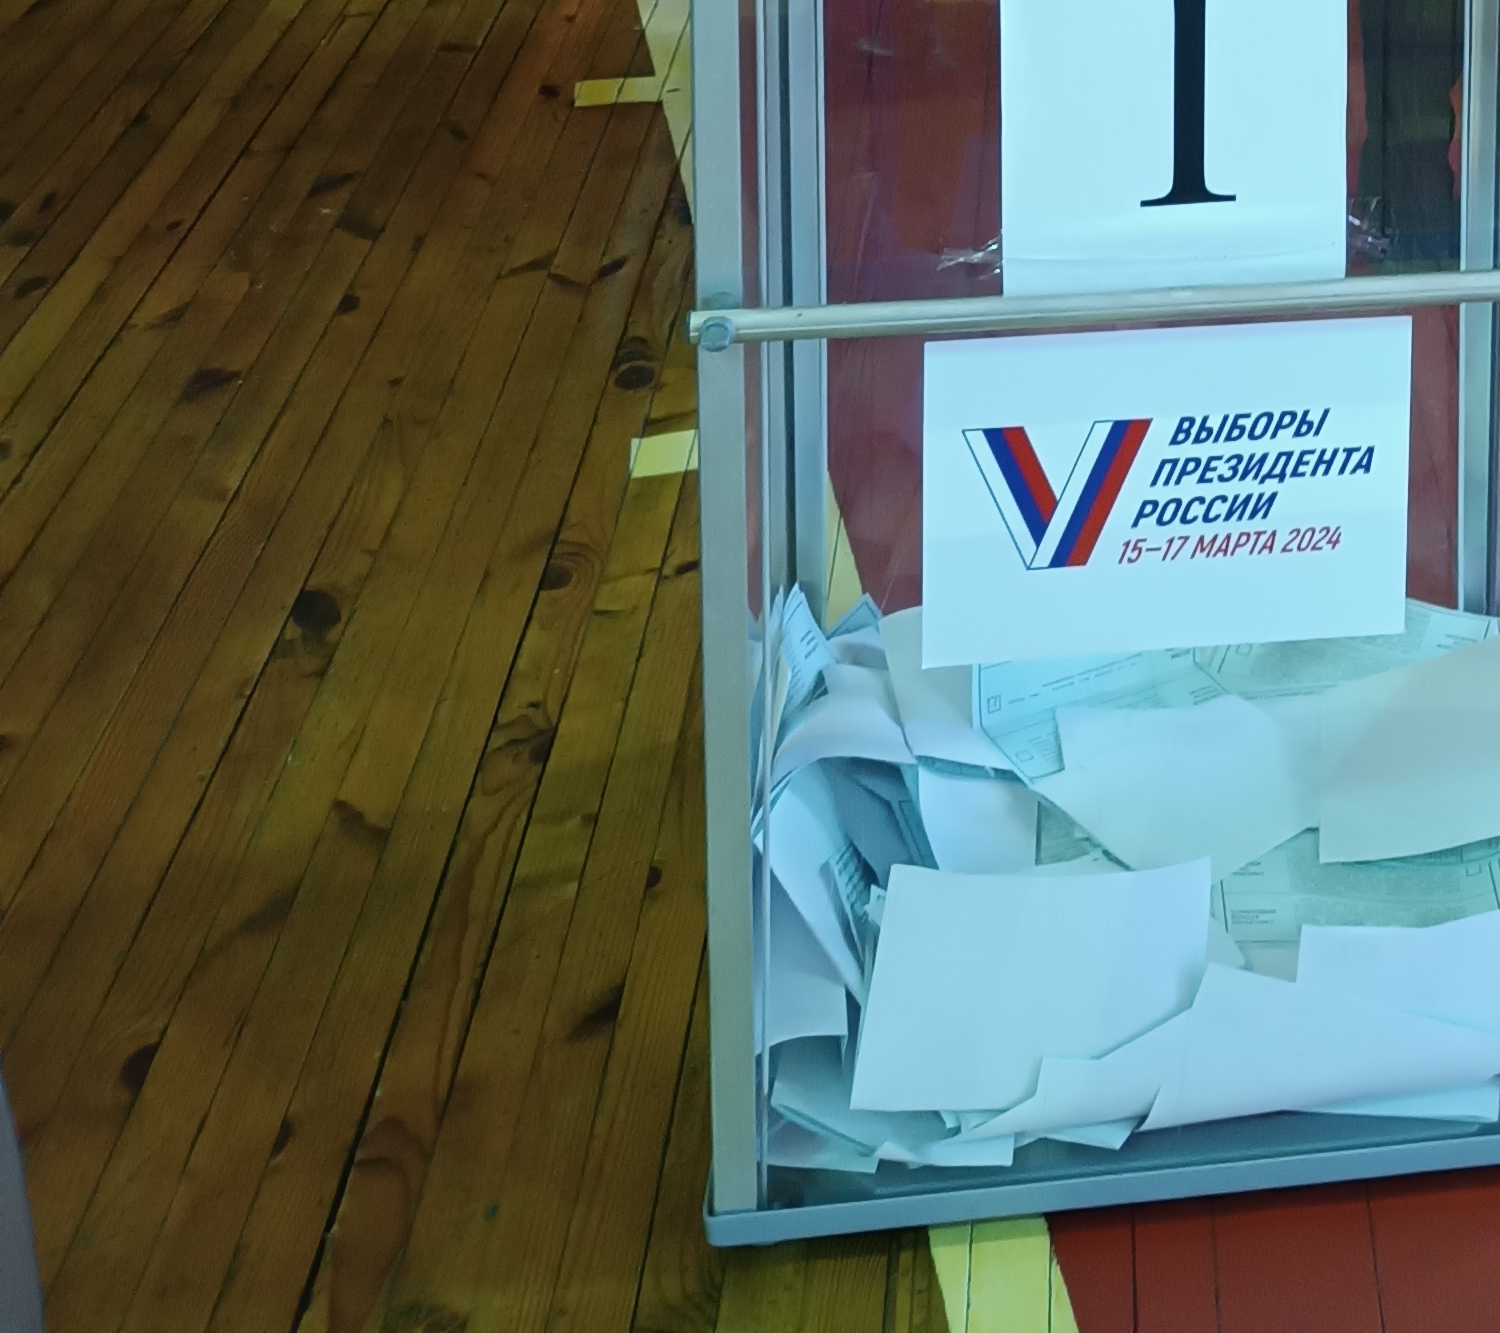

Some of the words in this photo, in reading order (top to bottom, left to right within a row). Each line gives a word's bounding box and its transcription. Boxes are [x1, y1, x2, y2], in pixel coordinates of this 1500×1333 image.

[1168, 407, 1332, 447] ВЫБОРЫ
[1149, 445, 1376, 489] ПРЕЗИДЕНТА
[1130, 491, 1279, 529] РОССИИ
[1189, 530, 1276, 560] МАРТА
[1279, 525, 1342, 555] 2024
